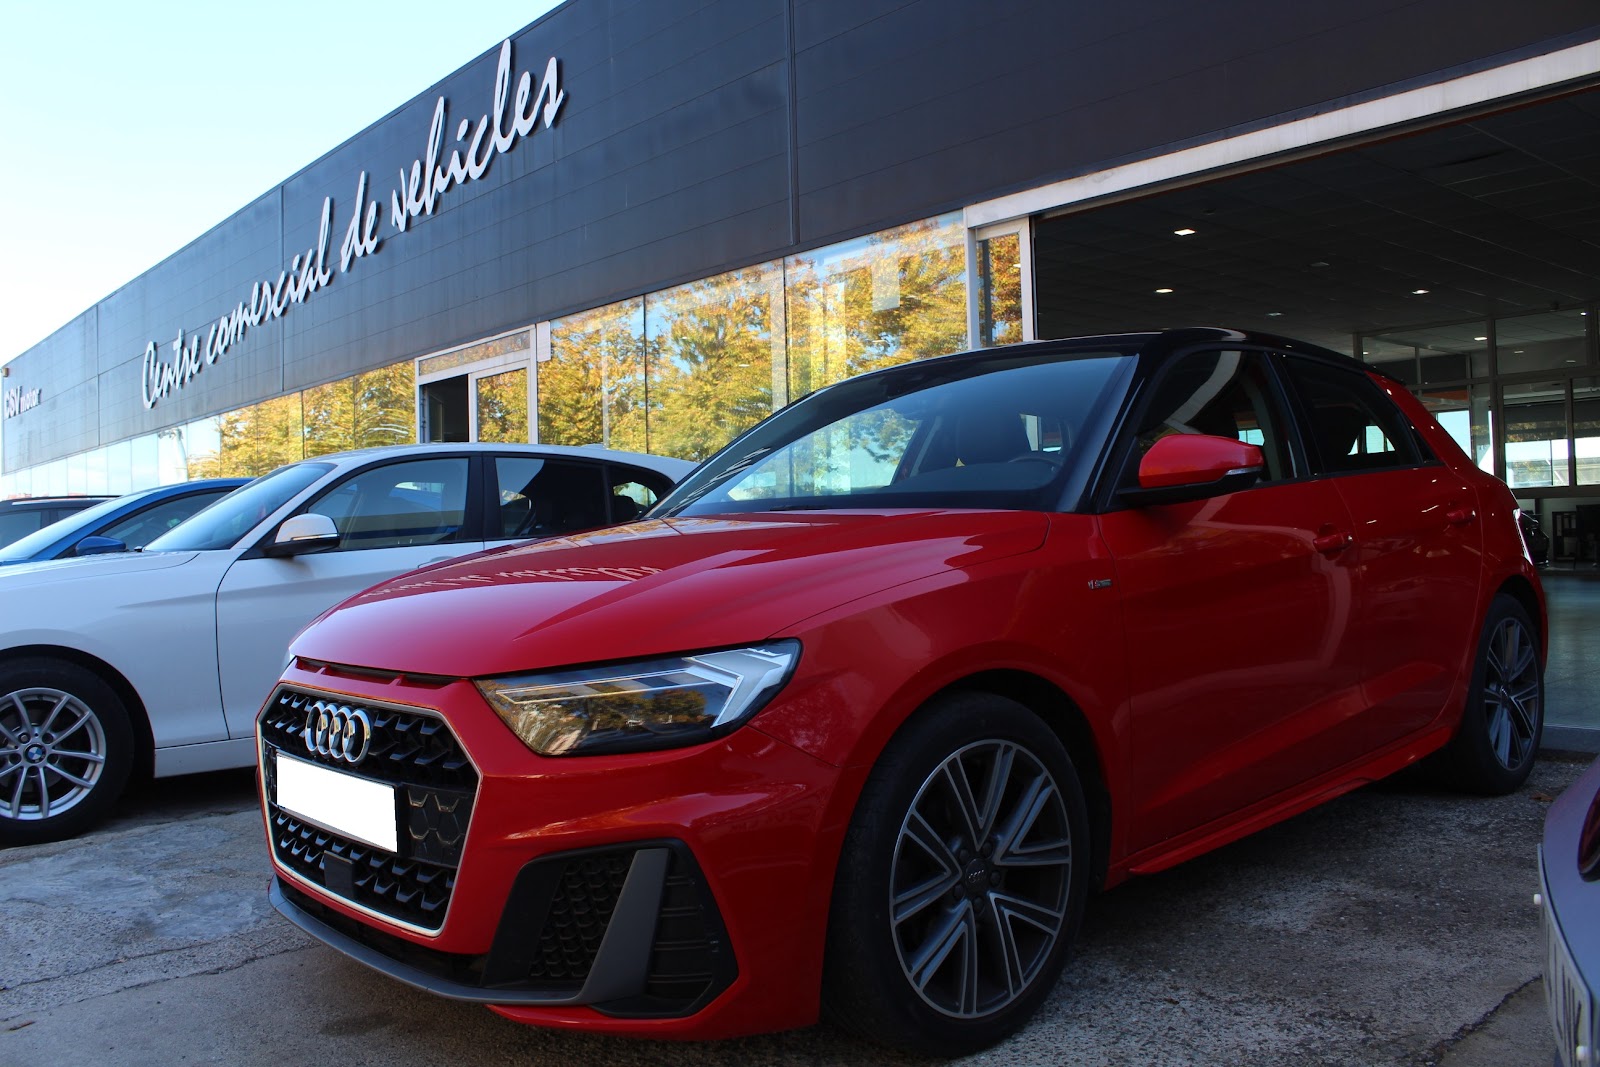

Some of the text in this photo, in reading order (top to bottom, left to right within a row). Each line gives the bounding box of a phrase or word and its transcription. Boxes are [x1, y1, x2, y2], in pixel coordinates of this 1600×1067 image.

[142, 38, 565, 410] Centre comercial de vehicles
